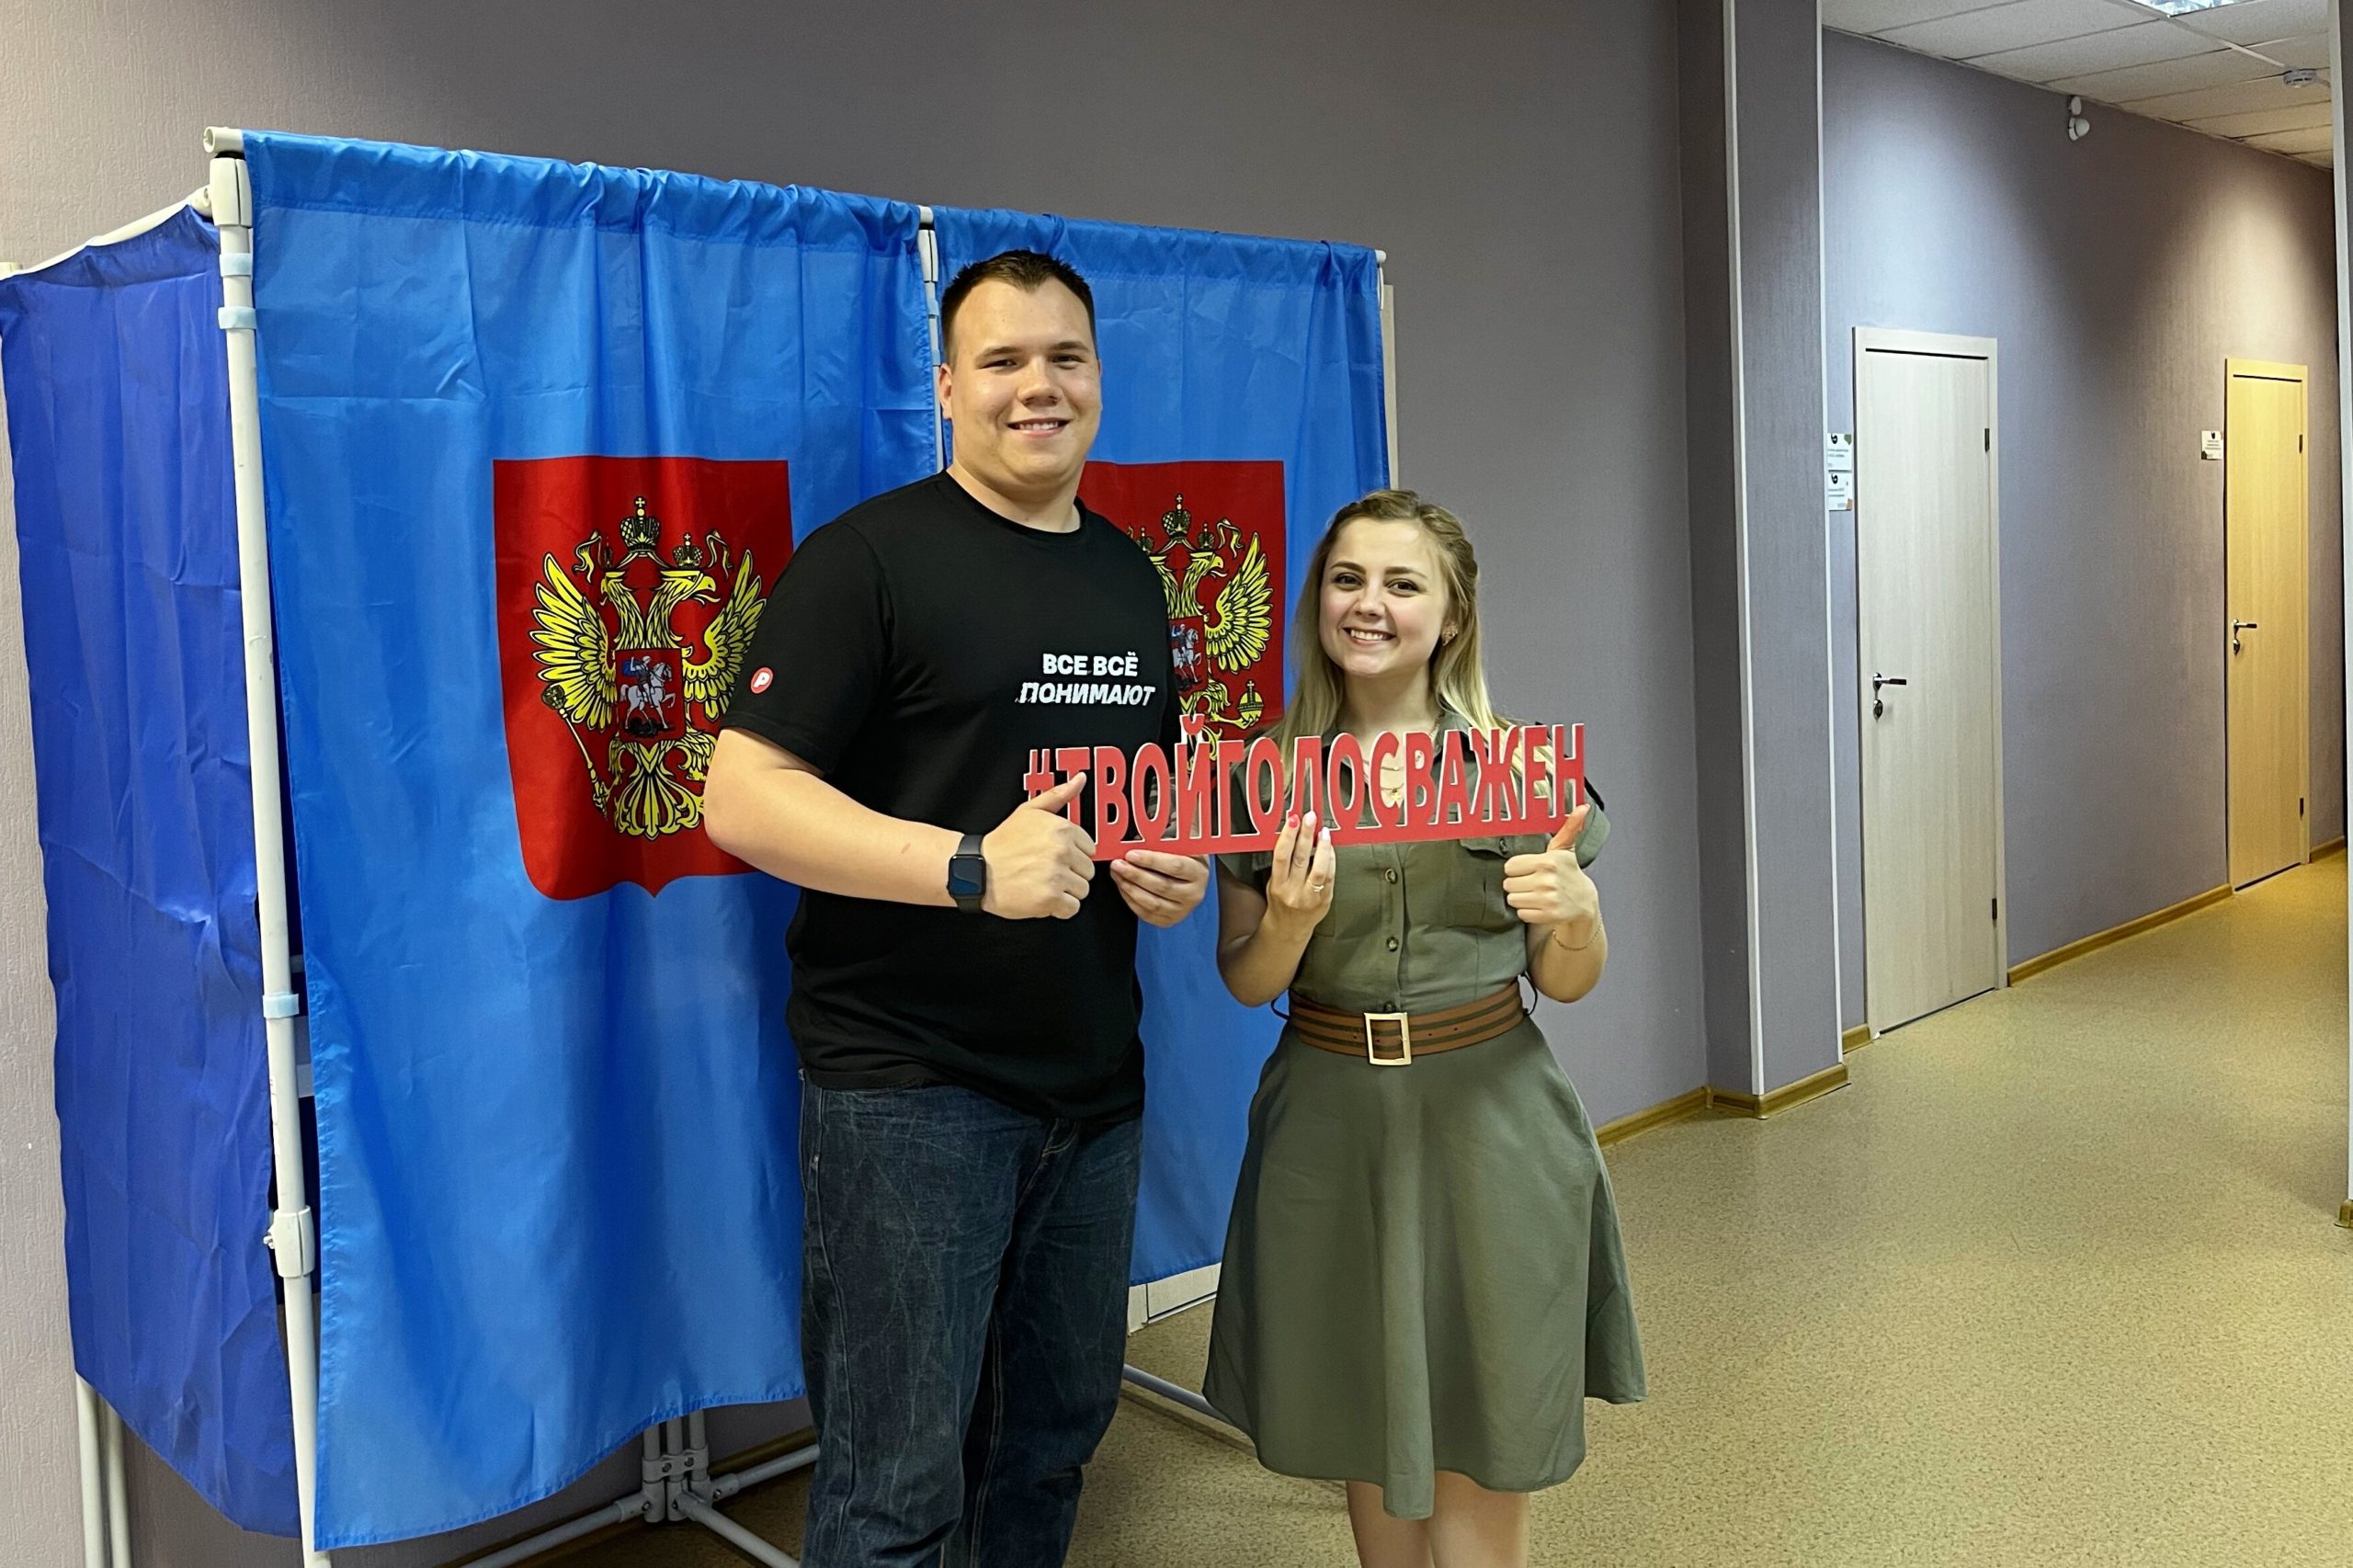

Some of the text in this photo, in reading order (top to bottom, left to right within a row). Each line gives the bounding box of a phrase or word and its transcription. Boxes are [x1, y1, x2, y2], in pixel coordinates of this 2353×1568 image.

[1042, 651, 1139, 676] ВСЕ ВСЁ
[1018, 682, 1156, 706] ПОНИМАЮТ
